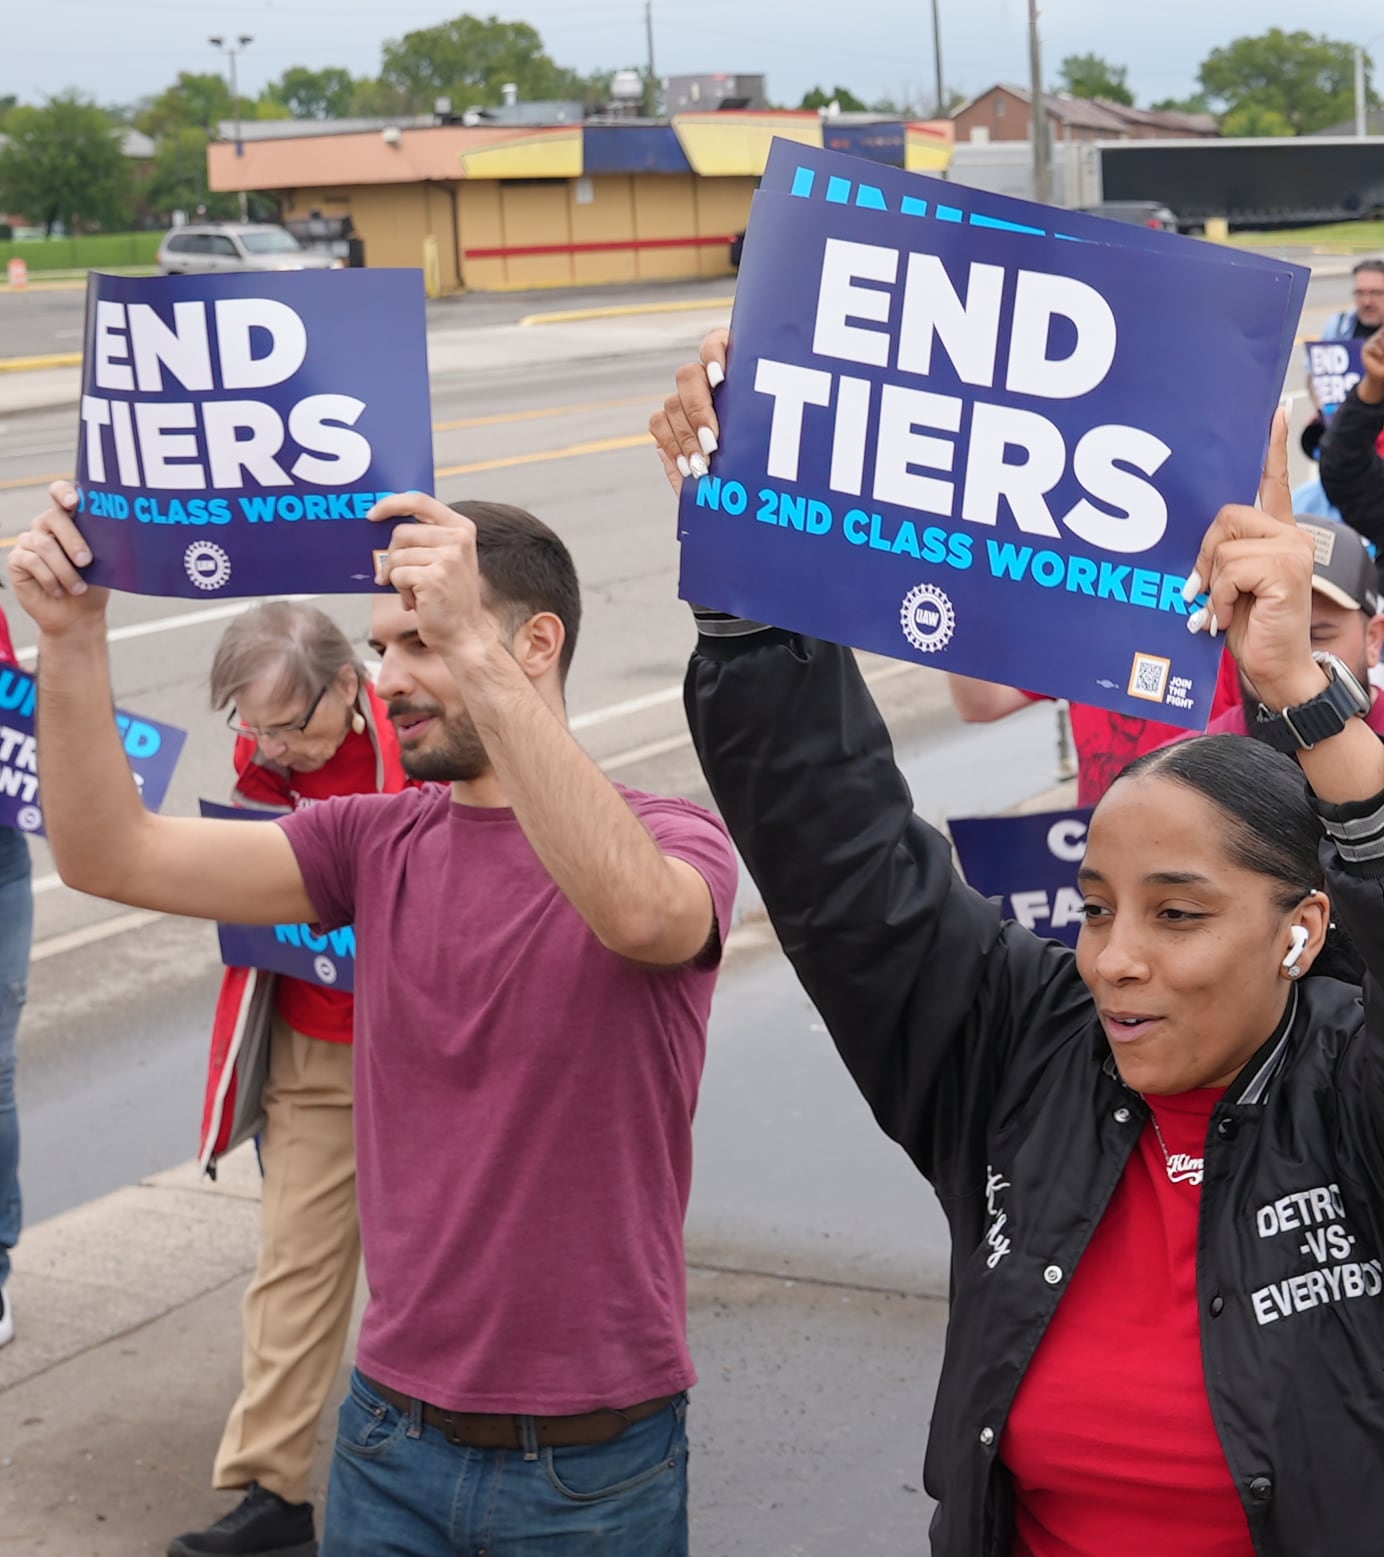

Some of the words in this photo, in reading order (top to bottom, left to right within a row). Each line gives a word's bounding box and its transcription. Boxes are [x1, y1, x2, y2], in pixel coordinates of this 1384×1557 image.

[96, 298, 307, 392] END
[813, 238, 1117, 399] END
[1310, 344, 1350, 376] END
[81, 394, 372, 490] TIERS
[754, 358, 1172, 554] TIERS
[90, 491, 130, 520] 2ND
[134, 497, 233, 526] CLASS
[696, 476, 748, 516] NO
[757, 488, 833, 536] 2ND
[843, 509, 974, 571] CLASS
[1166, 695, 1194, 709] FIGHT
[1168, 686, 1187, 699] THE
[1169, 676, 1192, 690] JOIN
